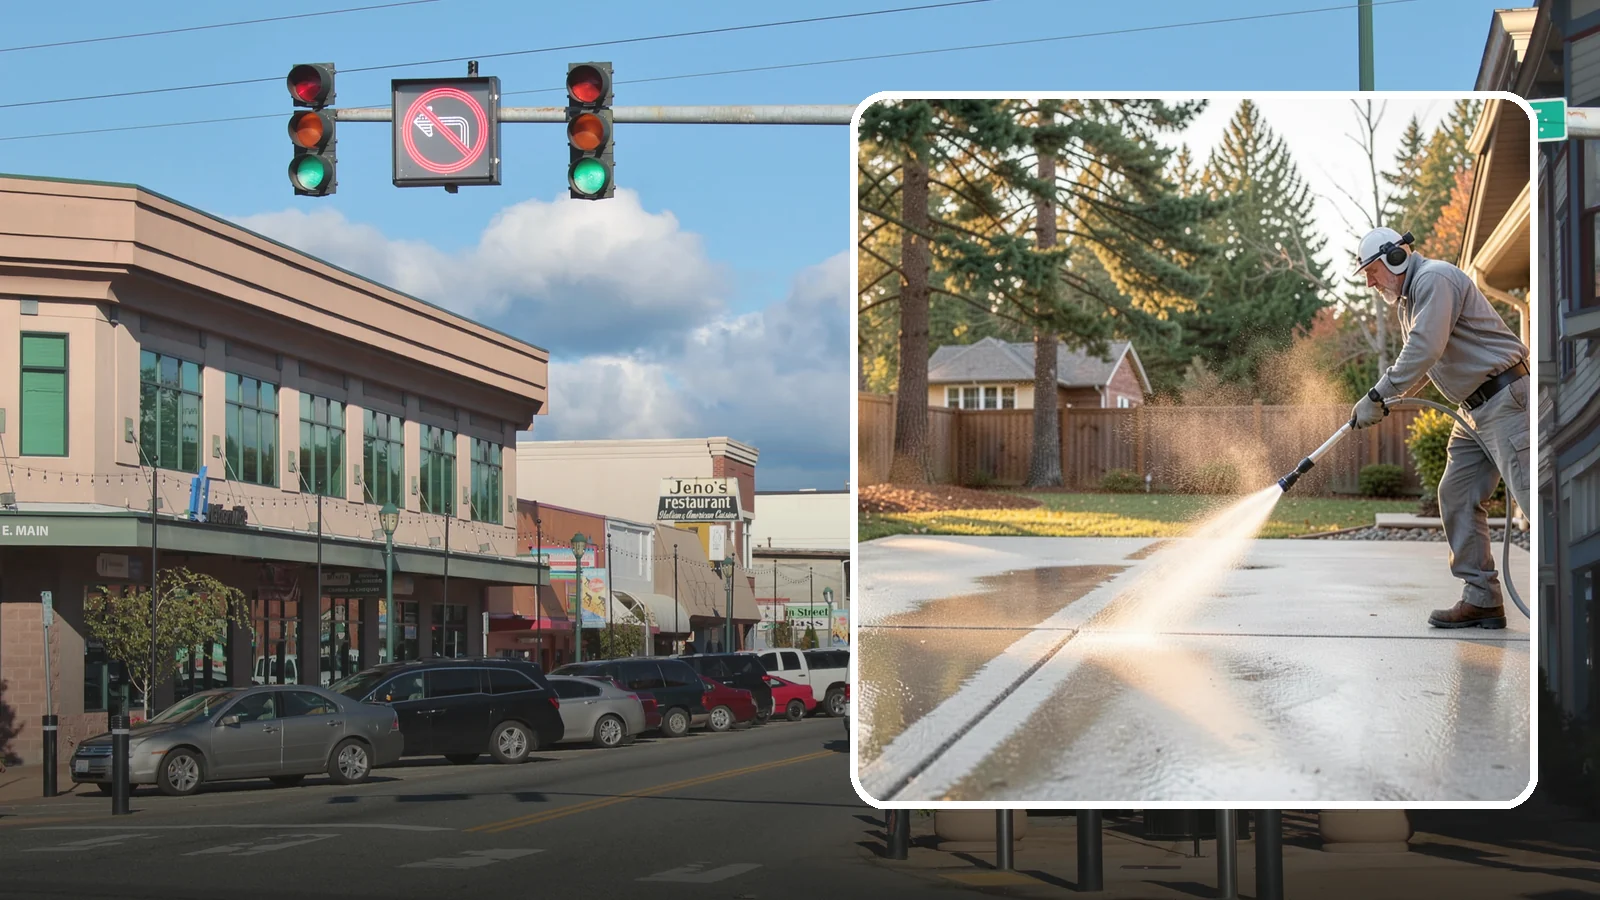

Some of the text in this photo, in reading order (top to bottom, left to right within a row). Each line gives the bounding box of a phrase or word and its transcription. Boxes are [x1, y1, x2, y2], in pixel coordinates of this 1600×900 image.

[670, 480, 727, 494] Jeno's
[665, 496, 731, 509] restaurant
[659, 510, 681, 519] Italian
[686, 510, 714, 519] American
[715, 510, 737, 519] Cuisine
[2, 525, 49, 536] E. MAIN
[785, 607, 828, 616] in Street
